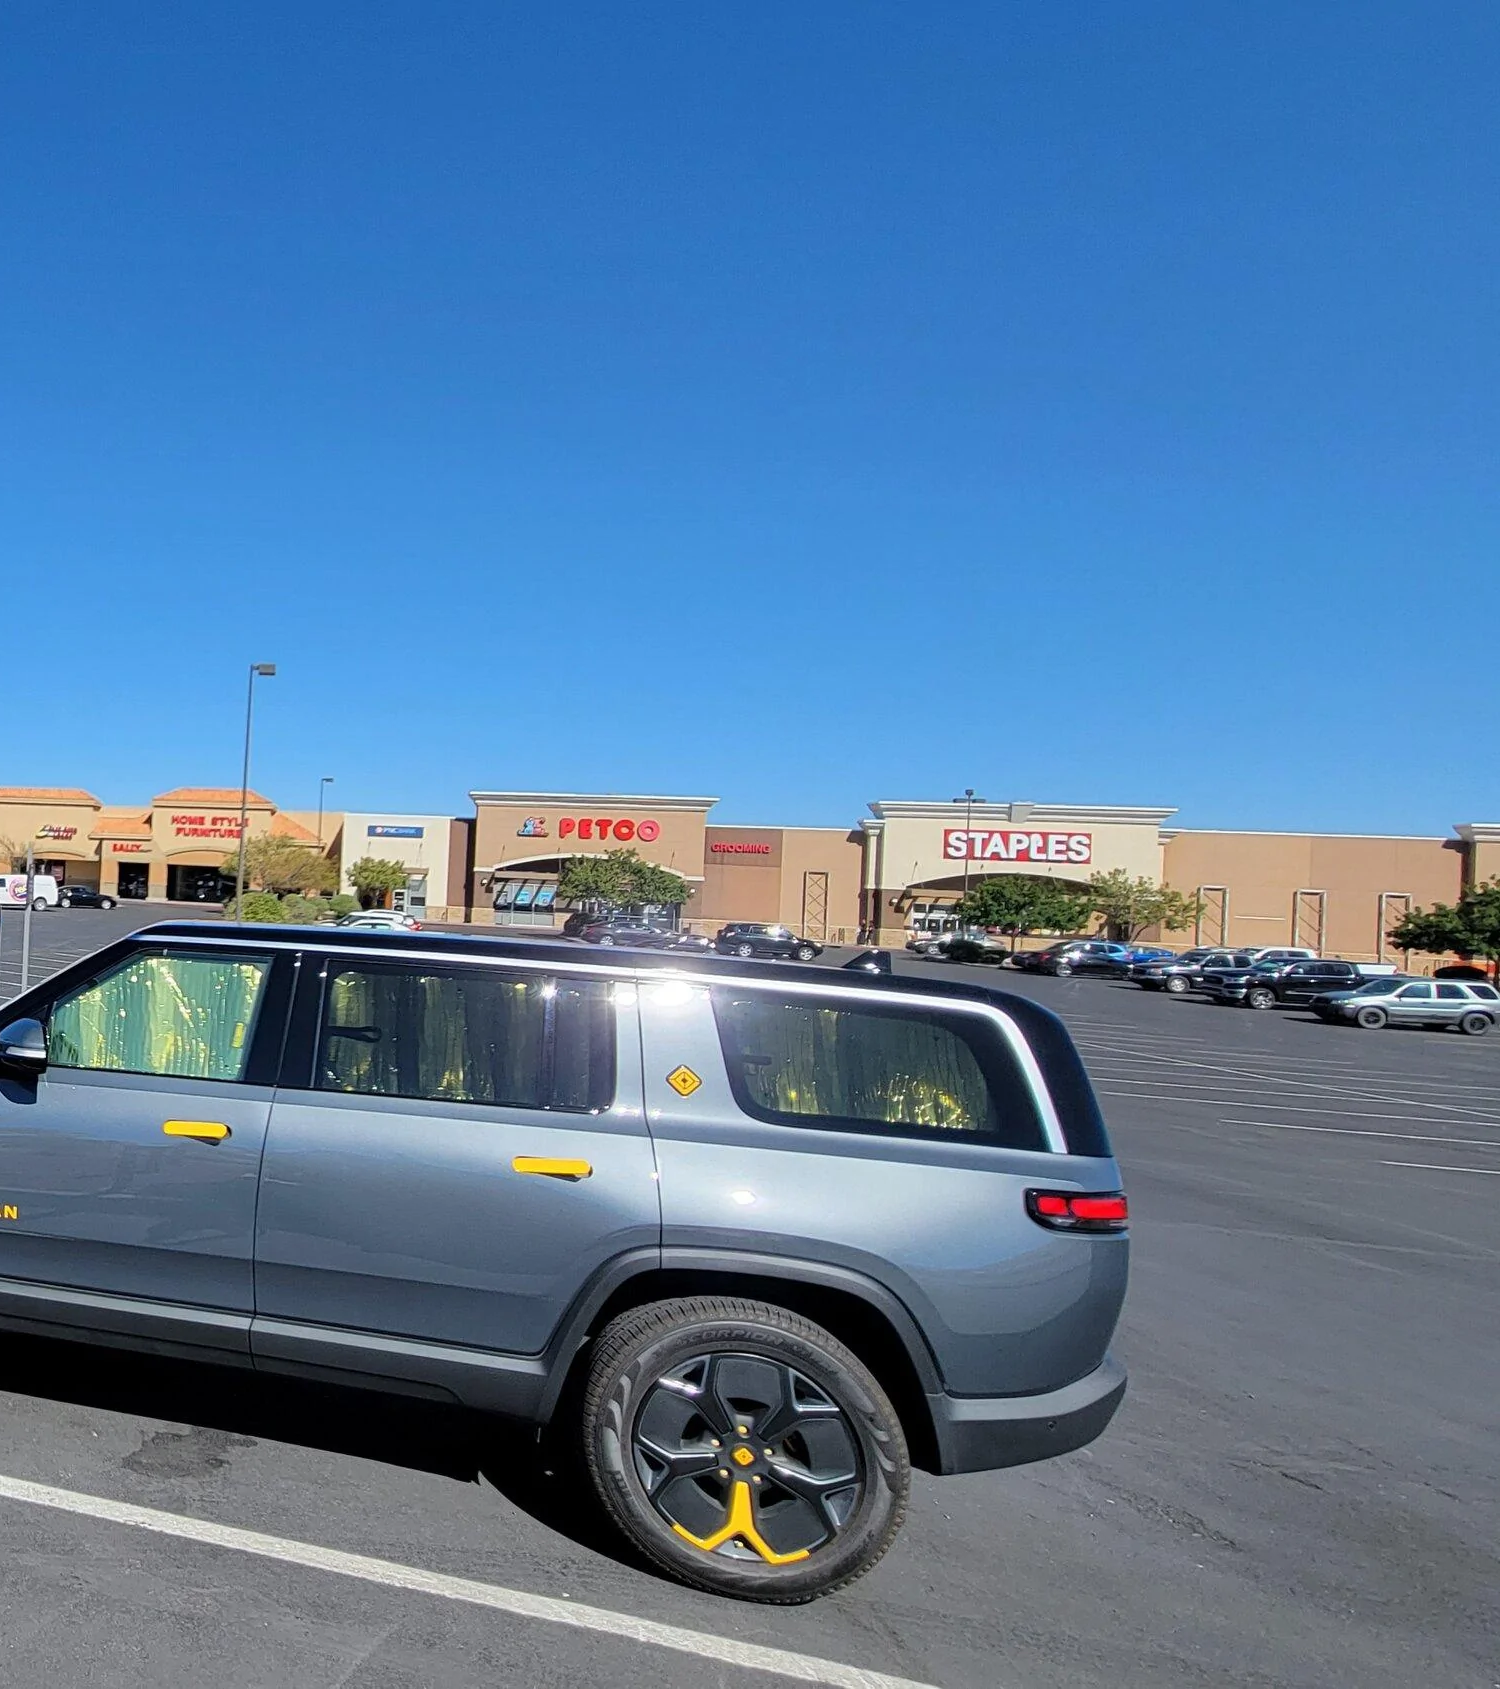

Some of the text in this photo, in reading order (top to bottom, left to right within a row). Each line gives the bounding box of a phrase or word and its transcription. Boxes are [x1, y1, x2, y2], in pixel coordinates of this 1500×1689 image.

[171, 815, 250, 827] HOME STYLE
[175, 828, 242, 838] FURNITURE
[559, 818, 660, 842] PETCO
[711, 842, 771, 854] GROOMING
[946, 831, 1091, 862] STAPLES
